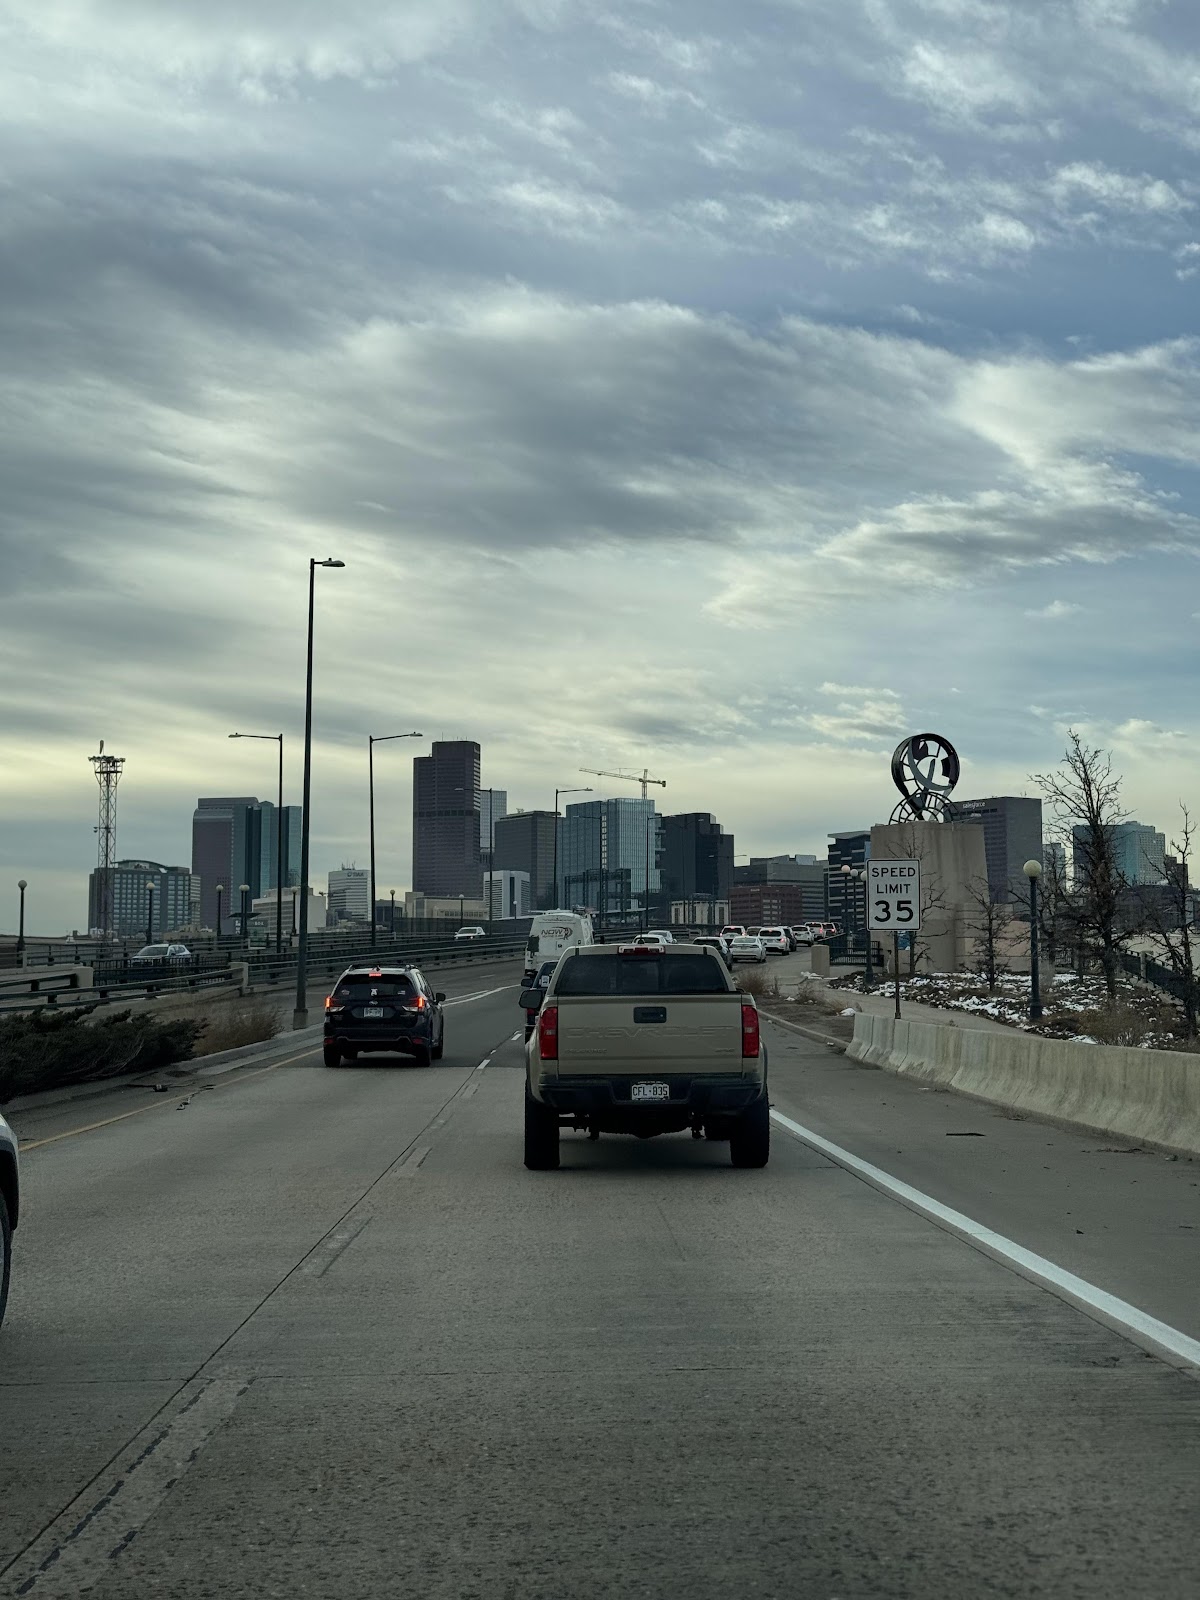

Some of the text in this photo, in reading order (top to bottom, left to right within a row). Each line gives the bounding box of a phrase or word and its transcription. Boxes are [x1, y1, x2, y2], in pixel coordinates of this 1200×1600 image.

[962, 801, 986, 809] salesforce
[871, 867, 916, 878] SPEED
[876, 883, 911, 894] LIMIT
[874, 900, 914, 922] 35
[566, 1026, 735, 1038] CHEVROLET
